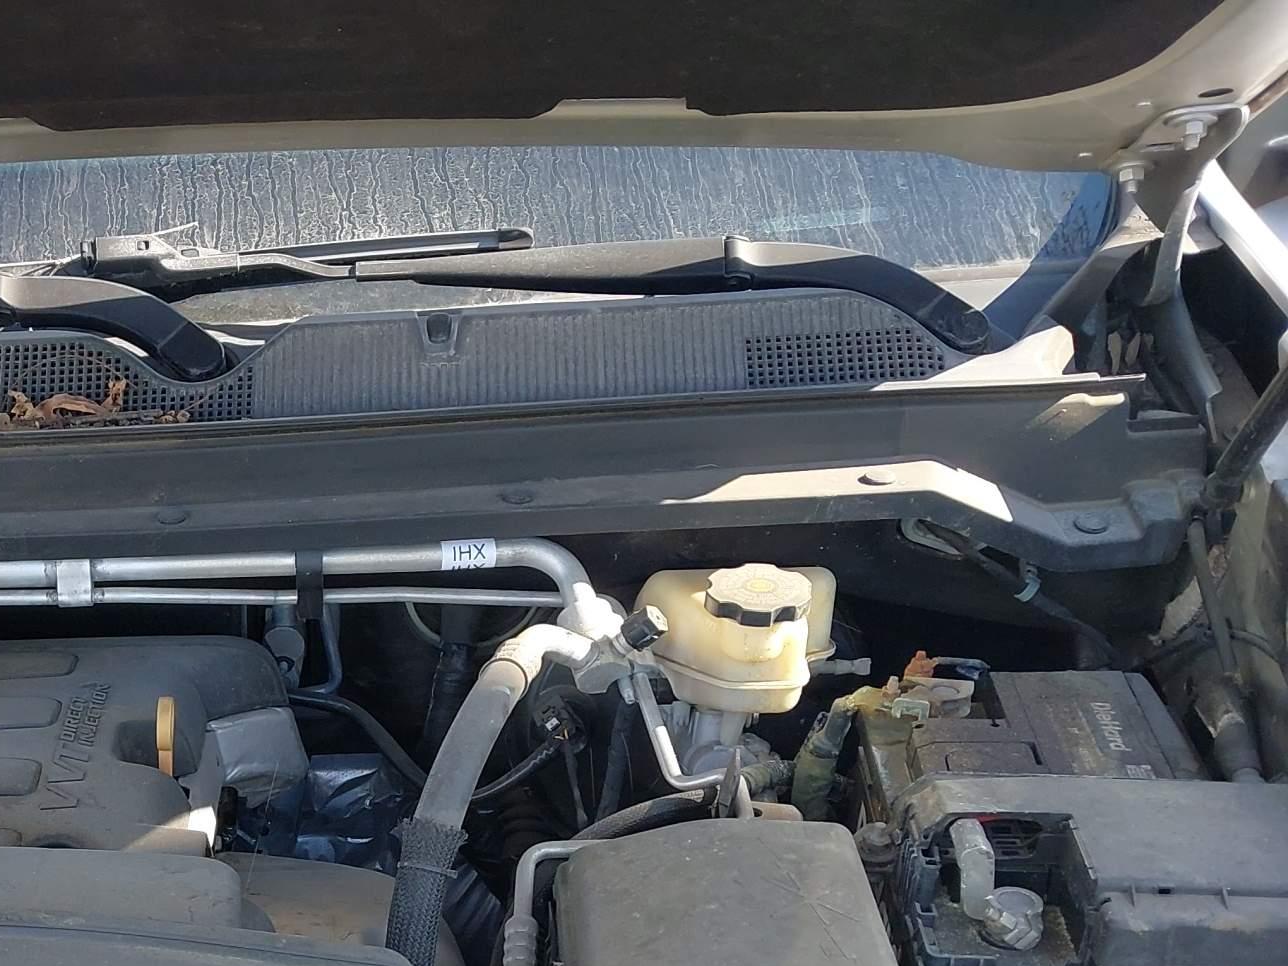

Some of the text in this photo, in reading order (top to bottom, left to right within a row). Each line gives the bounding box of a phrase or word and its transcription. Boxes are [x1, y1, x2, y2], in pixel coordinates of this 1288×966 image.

[453, 543, 486, 561] IHX
[60, 696, 88, 742] DIRECT
[78, 682, 111, 747] INJECTION
[1090, 702, 1133, 752] DieHard
